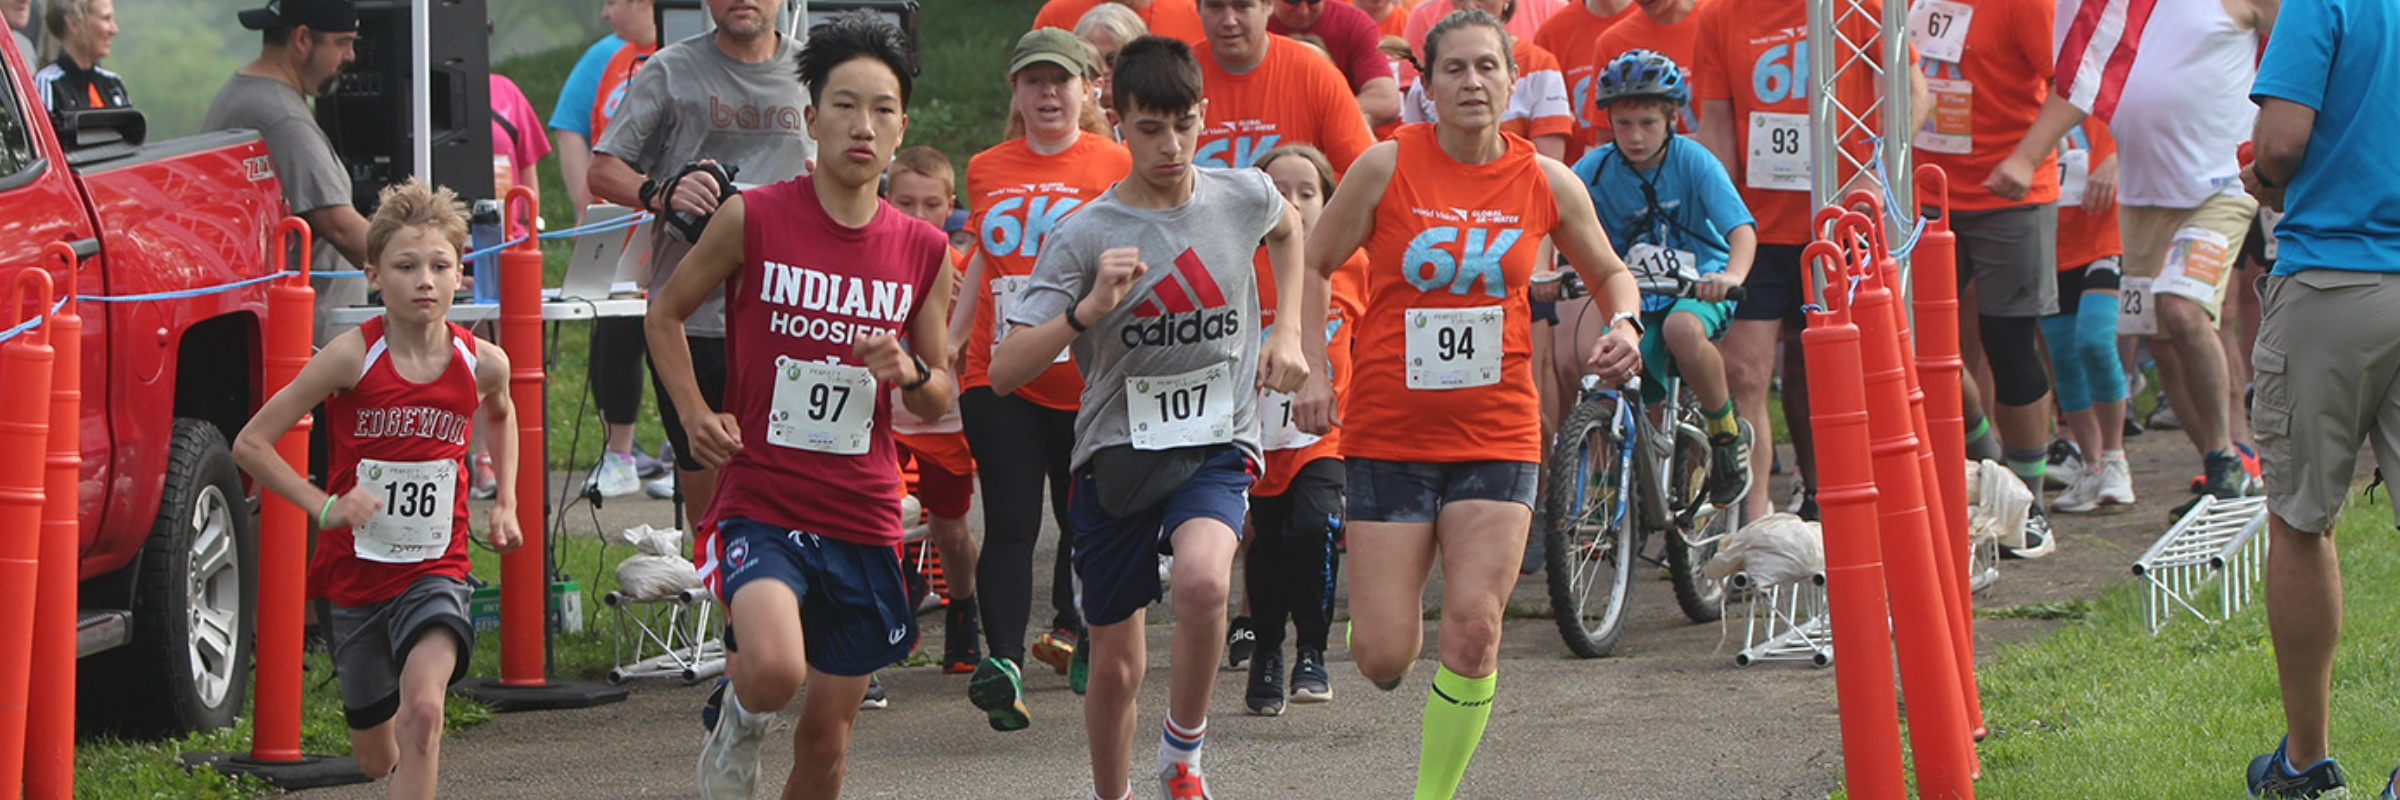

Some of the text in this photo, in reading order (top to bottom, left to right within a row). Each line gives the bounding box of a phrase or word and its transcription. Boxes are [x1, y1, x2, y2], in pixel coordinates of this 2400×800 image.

[1928, 12, 1953, 38] 67
[709, 95, 801, 130] bara
[1772, 128, 1799, 154] 93
[981, 195, 1084, 257] 6K
[1402, 226, 1525, 299] 6K
[1639, 248, 1681, 284] 118
[760, 261, 914, 322] INDIANA
[769, 310, 899, 346] HOOSIE
[1121, 308, 1239, 349] adidas
[1438, 326, 1475, 362] 94
[808, 383, 851, 423] 97
[1154, 383, 1208, 423] 107
[384, 480, 438, 518] 136
